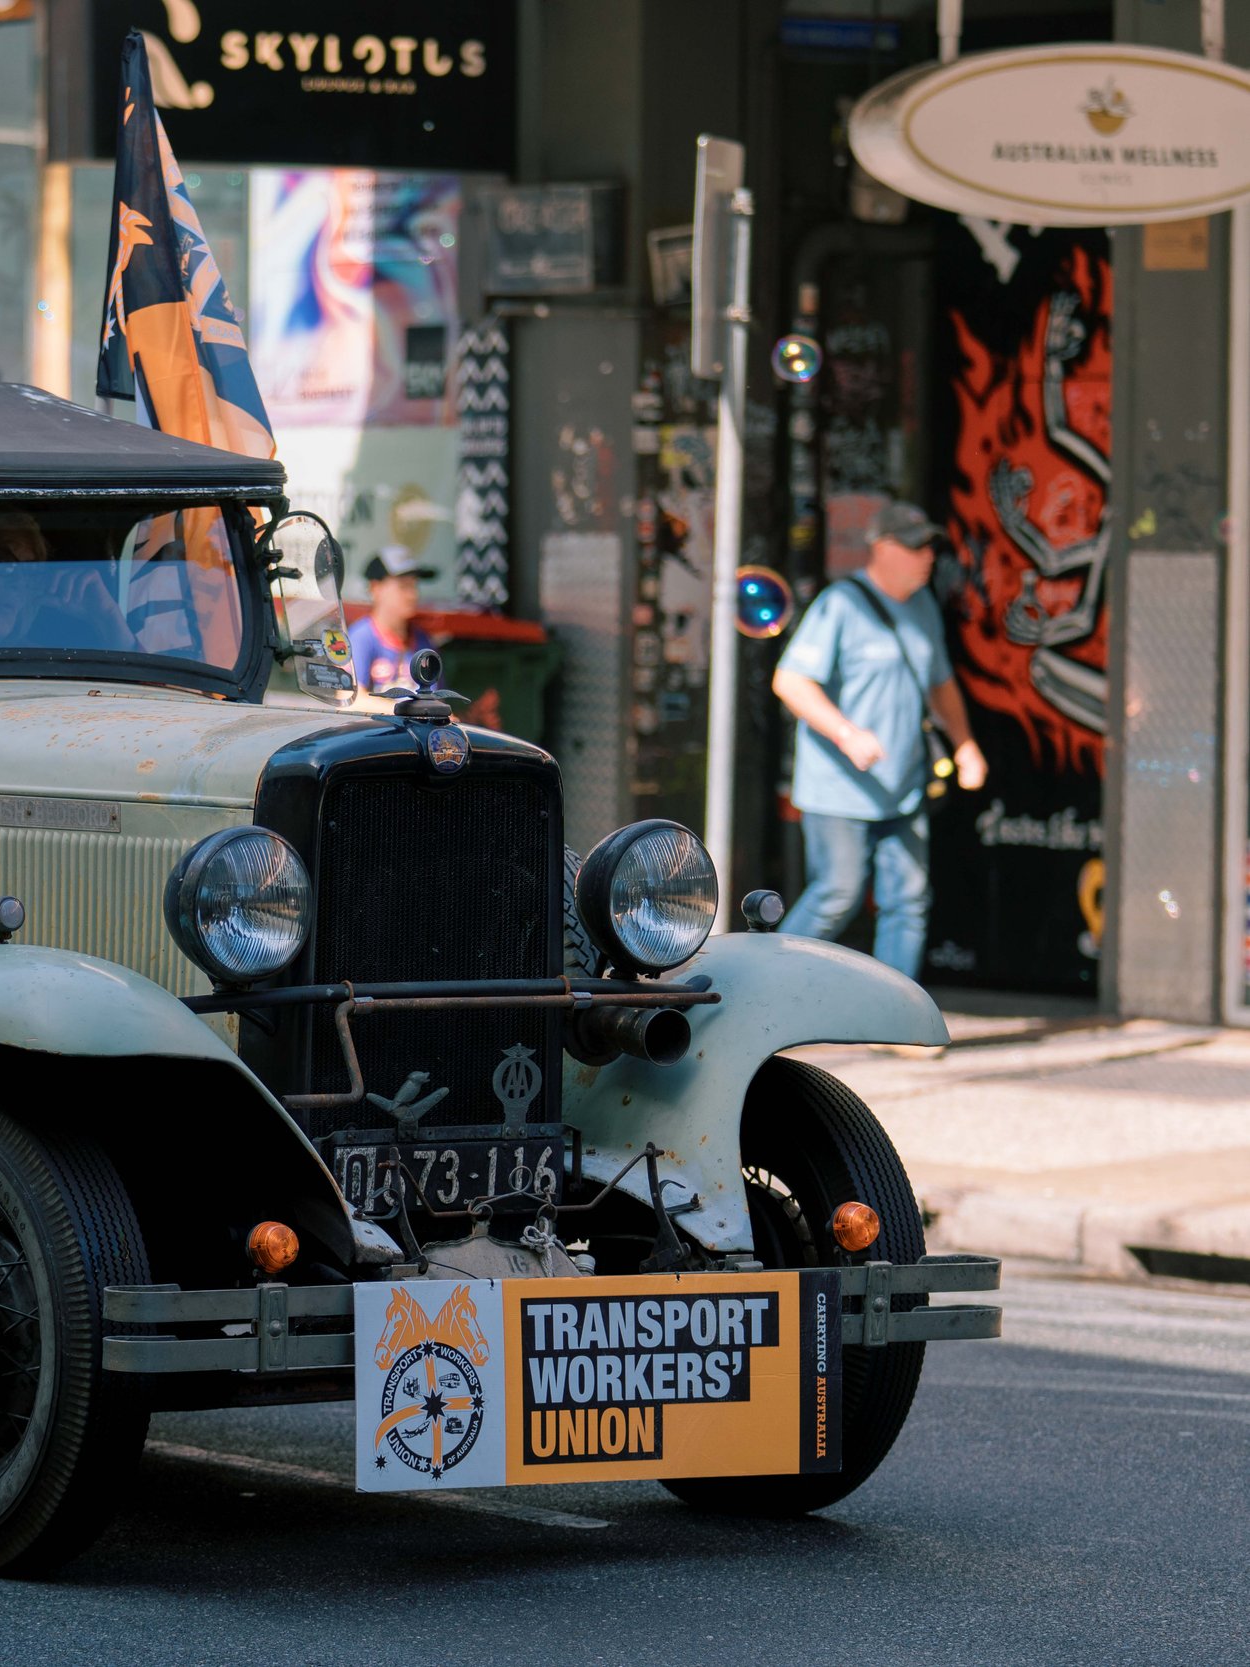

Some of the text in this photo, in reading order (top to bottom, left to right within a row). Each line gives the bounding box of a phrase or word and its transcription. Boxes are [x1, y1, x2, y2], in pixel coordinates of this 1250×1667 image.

[220, 29, 487, 78] SKYLOTUS
[992, 141, 1219, 167] AUSTRALIAN WELLNESS
[527, 1298, 769, 1350] TRANSPORT
[383, 1349, 419, 1414] TRANSPORT
[528, 1351, 742, 1404] WORKERS'
[816, 1293, 826, 1459] CARRYING AUSTRALIA
[387, 1432, 419, 1469] UNION
[447, 1419, 480, 1465] OF AUSTRALIA
[531, 1407, 655, 1458] UNION
